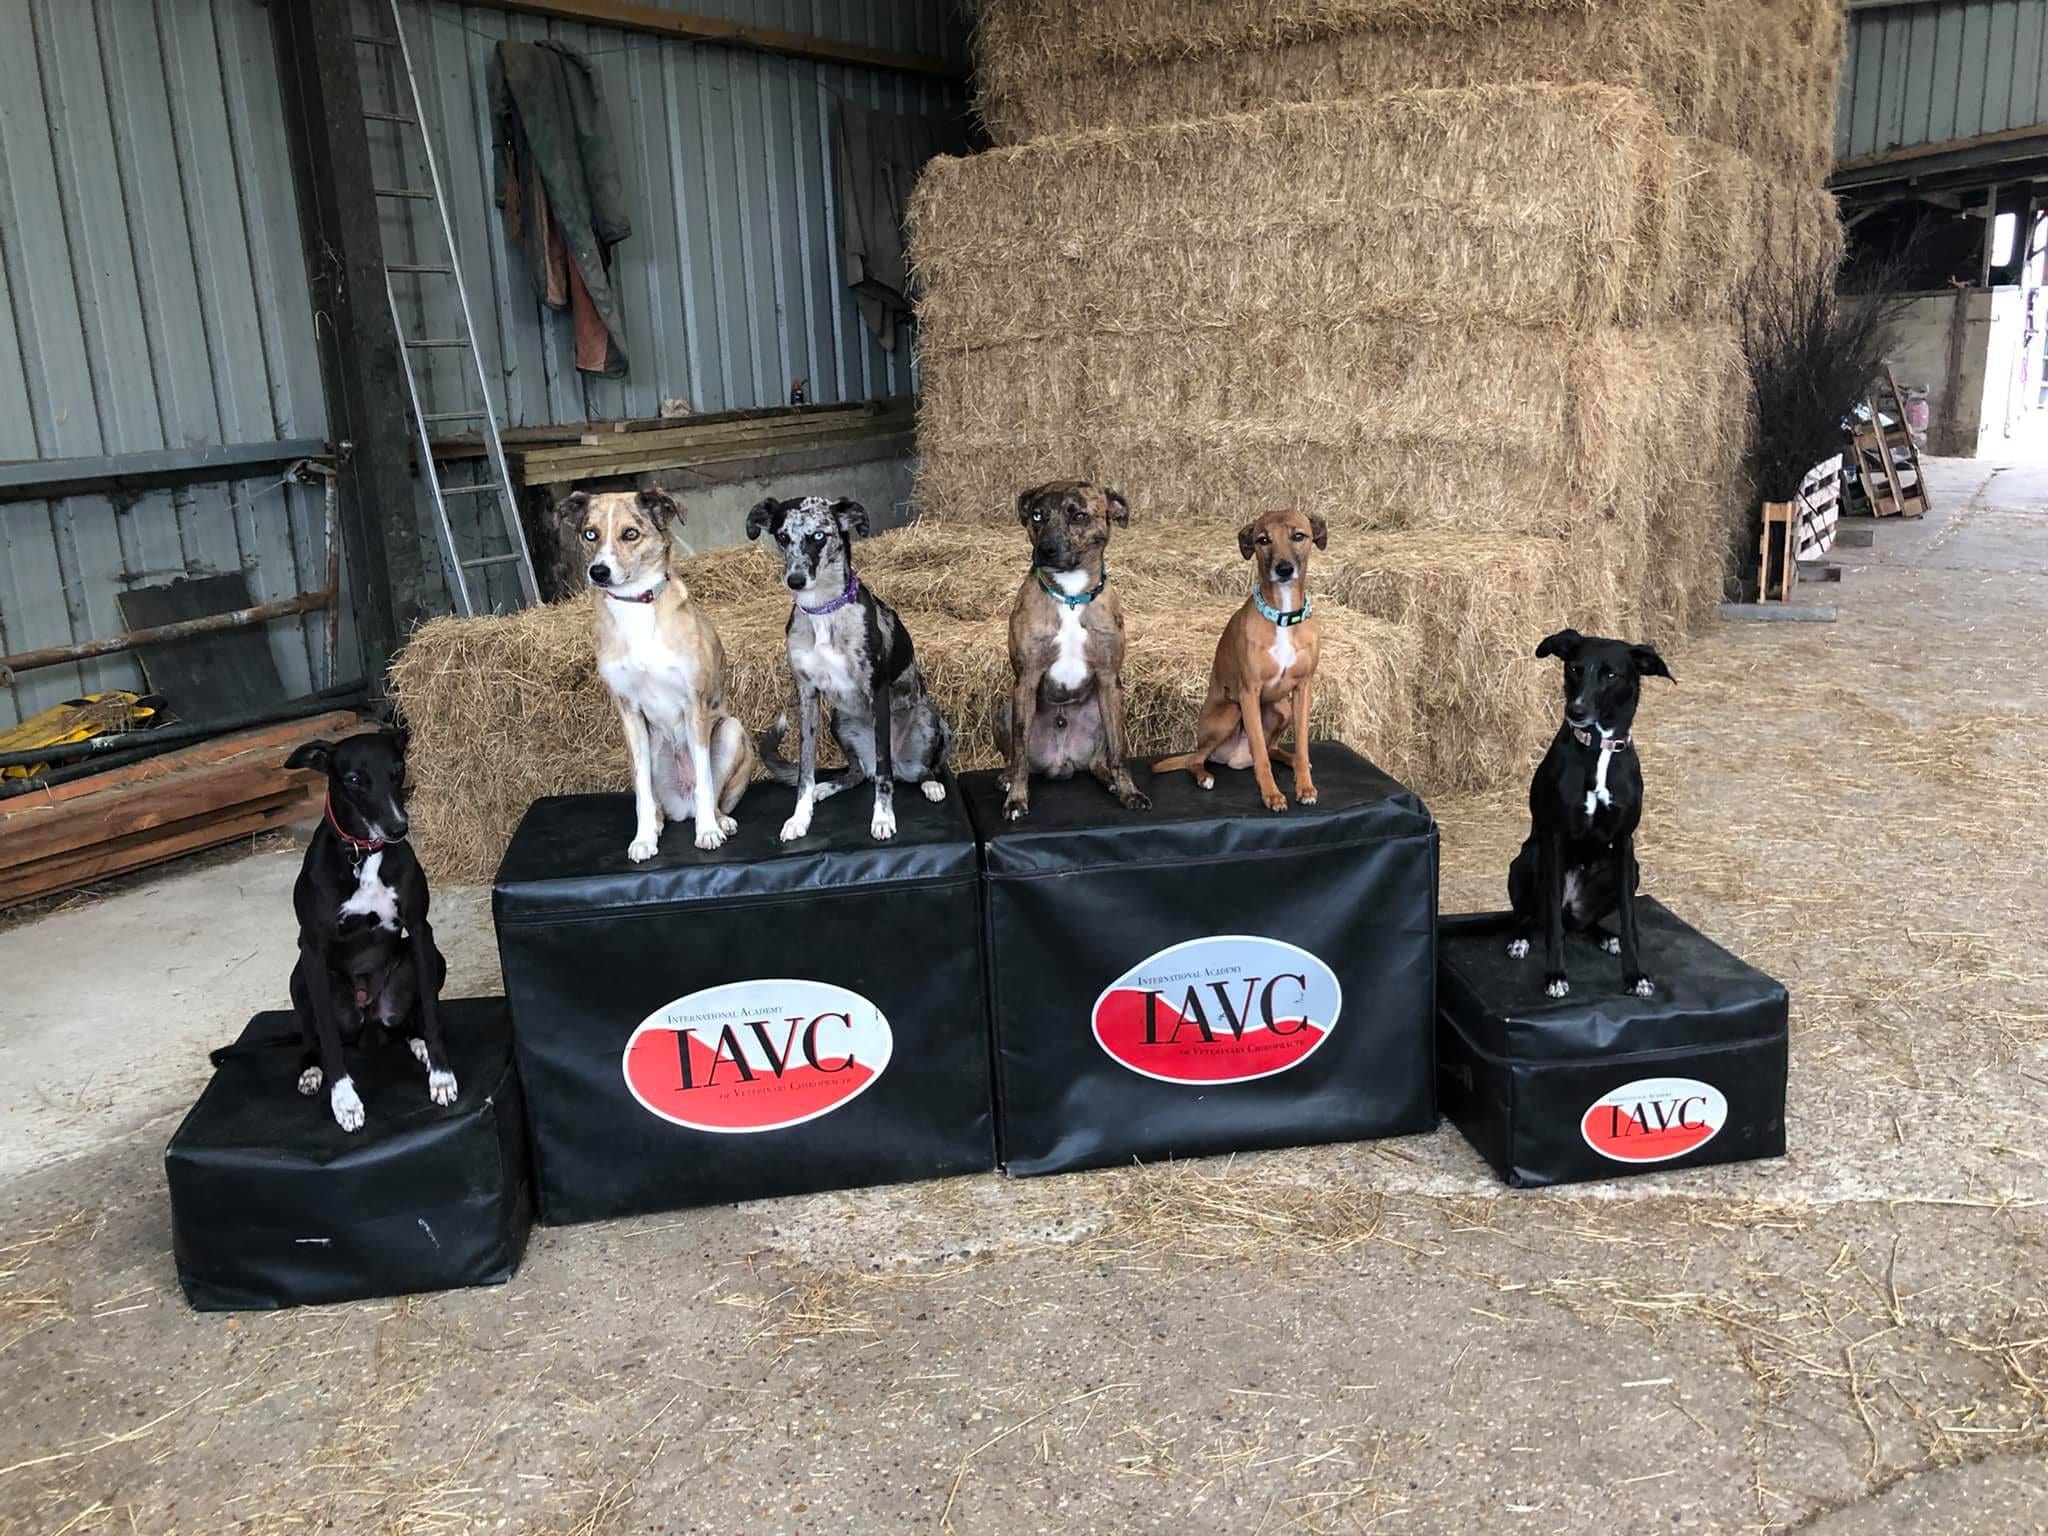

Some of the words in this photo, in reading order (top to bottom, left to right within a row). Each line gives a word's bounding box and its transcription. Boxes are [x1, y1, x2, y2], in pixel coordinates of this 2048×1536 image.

[1137, 973, 1308, 1045] IAVC
[668, 1012, 855, 1092] IAVC
[1607, 1096, 1707, 1140] IAVC
